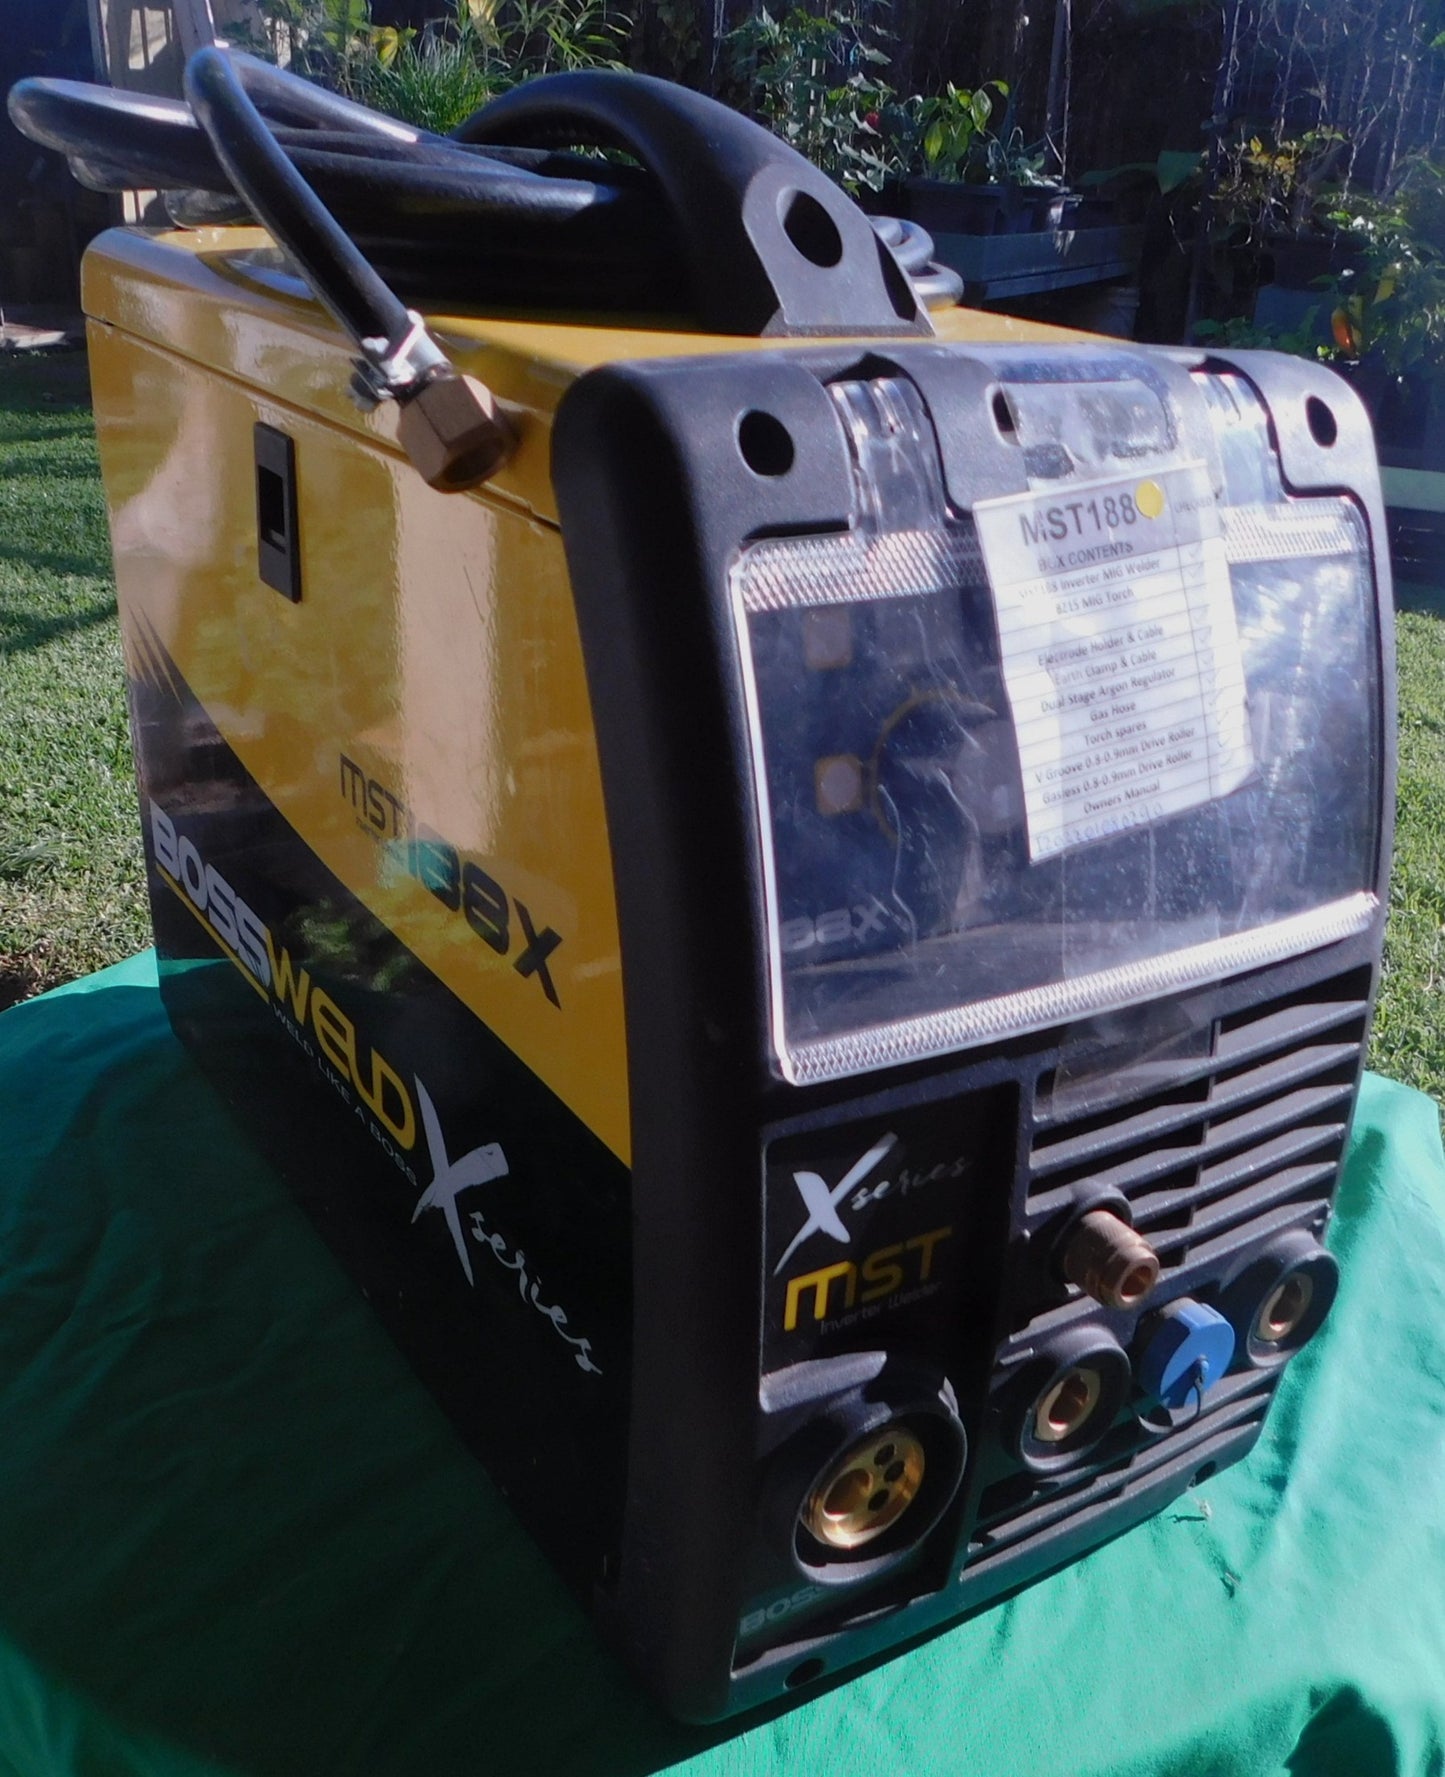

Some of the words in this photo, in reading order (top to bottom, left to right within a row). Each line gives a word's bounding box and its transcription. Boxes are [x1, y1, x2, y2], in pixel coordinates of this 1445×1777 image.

[1019, 492, 1138, 546] MST188
[1060, 570, 1100, 590] Inverter
[1103, 564, 1124, 582] MIG
[1126, 557, 1161, 575] Welder
[1068, 542, 1134, 566] CONTENTS
[1082, 592, 1104, 609] MIG
[1106, 585, 1135, 603] Torch
[1038, 645, 1088, 667] Electrode
[1090, 634, 1124, 654] Holder
[1137, 624, 1164, 641] Cable
[1053, 669, 1083, 688] Earth
[1085, 659, 1119, 680] Clamp
[1130, 648, 1158, 666] Cable
[1067, 688, 1096, 709] Stage
[1099, 680, 1129, 700] Argon
[1130, 666, 1176, 689] Regulator
[1089, 708, 1109, 722] Gas
[1111, 700, 1137, 717] Hose
[1045, 762, 1083, 781] Groove
[1141, 736, 1166, 752] Drive
[1167, 725, 1196, 743] Roller
[1083, 730, 1112, 747] Torch
[1115, 721, 1147, 742] spares
[1042, 783, 1081, 804] Gasless
[1138, 758, 1164, 775] Drive
[1165, 747, 1194, 765] Roller
[1083, 793, 1122, 814] Owners
[1124, 780, 1161, 799] Manual
[318, 1056, 352, 1106] LIKE
[354, 1104, 367, 1127] A
[370, 1120, 418, 1187] BOSS
